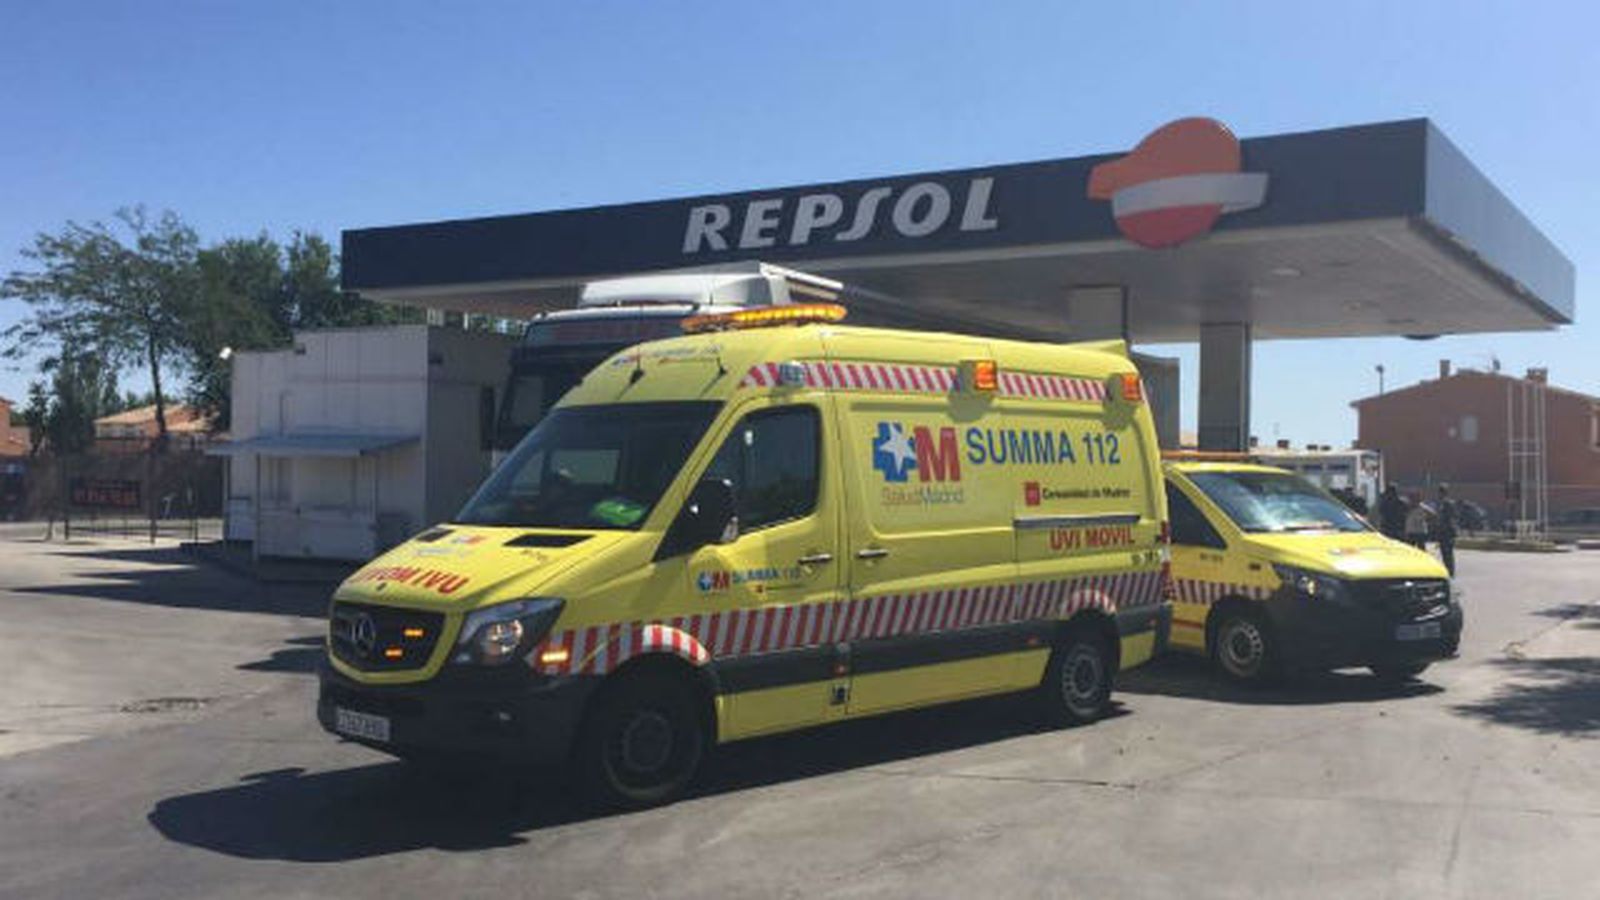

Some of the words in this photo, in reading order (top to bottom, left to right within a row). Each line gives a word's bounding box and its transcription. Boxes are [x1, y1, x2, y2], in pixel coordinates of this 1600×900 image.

[682, 177, 998, 254] REPSOL
[966, 428, 1076, 465] SUMMA
[1083, 433, 1121, 465] 112
[1049, 529, 1081, 551] UVI
